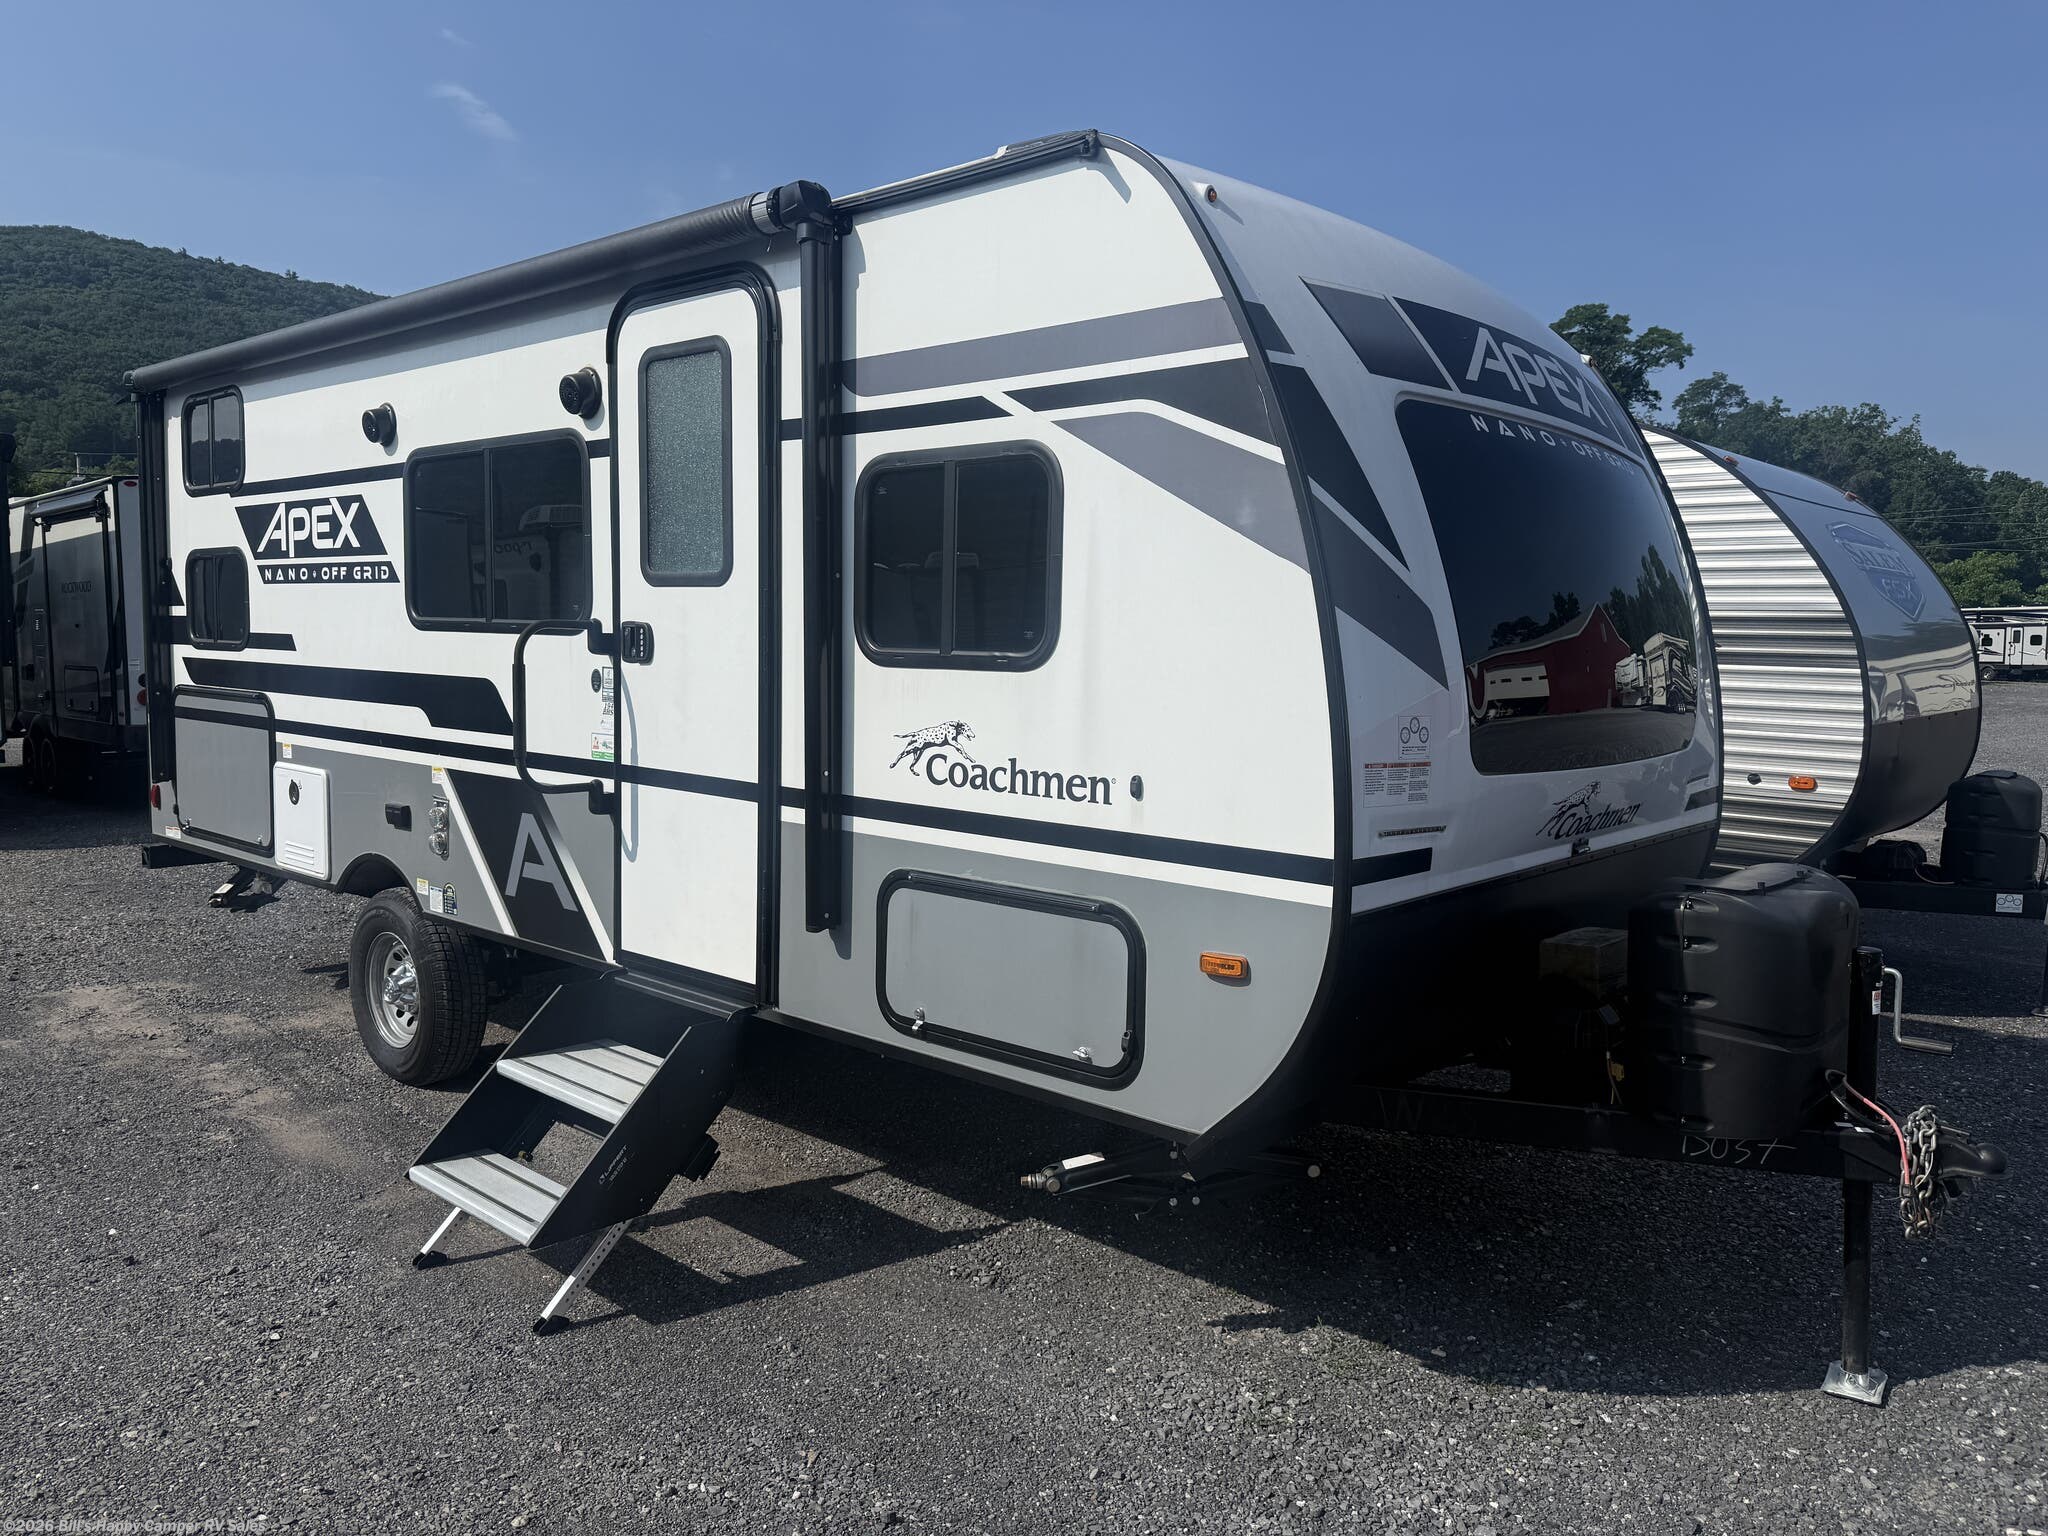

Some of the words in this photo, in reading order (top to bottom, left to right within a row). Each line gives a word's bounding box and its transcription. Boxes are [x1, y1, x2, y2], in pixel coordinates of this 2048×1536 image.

[1466, 327, 1608, 428] APEX
[1470, 414, 1556, 446] NANO
[256, 497, 361, 558] APEX
[264, 567, 308, 581] NANO
[321, 566, 347, 580] OFF
[353, 565, 390, 580] GRID
[926, 753, 1113, 806] Coachmen
[1553, 802, 1641, 840] Coachmen
[504, 812, 579, 912] A
